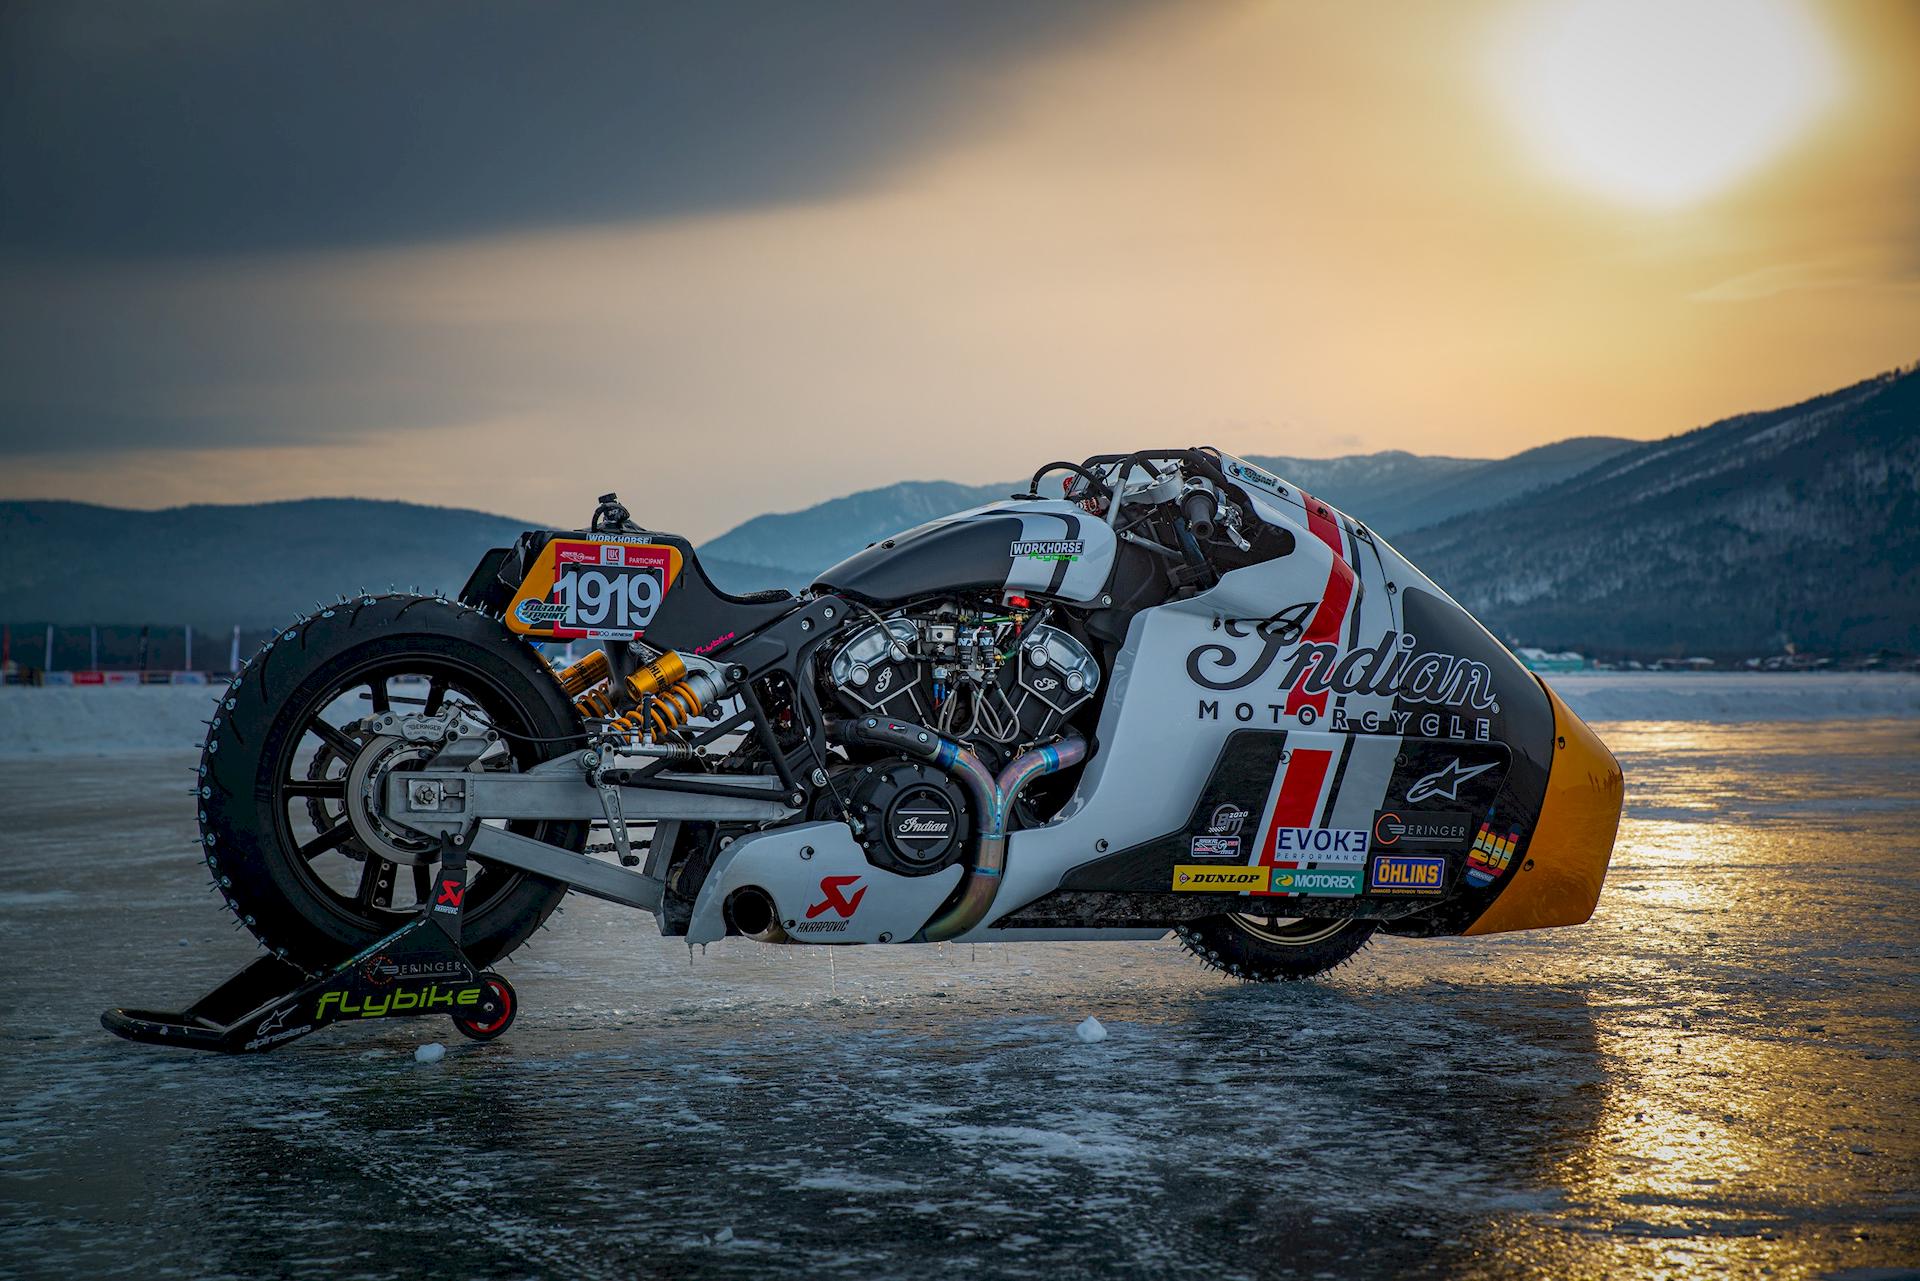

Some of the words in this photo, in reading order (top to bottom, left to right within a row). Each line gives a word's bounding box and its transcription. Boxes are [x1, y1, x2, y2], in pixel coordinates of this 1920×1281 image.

[1013, 542, 1082, 554] WORKHORSE
[629, 557, 664, 565] PARTICIPANT
[553, 571, 661, 627] 1919
[524, 603, 570, 612] SULTANS
[1186, 601, 1498, 710] Indian
[1199, 700, 1490, 742] MOTORCYCLE
[899, 817, 947, 832] Indian
[1276, 853, 1366, 861] PERFORMANCE
[1192, 874, 1259, 883] DUNLOP
[1378, 860, 1439, 883] ÖHLINS
[1294, 875, 1355, 888] MOTOREX
[316, 986, 480, 1020] flybike
